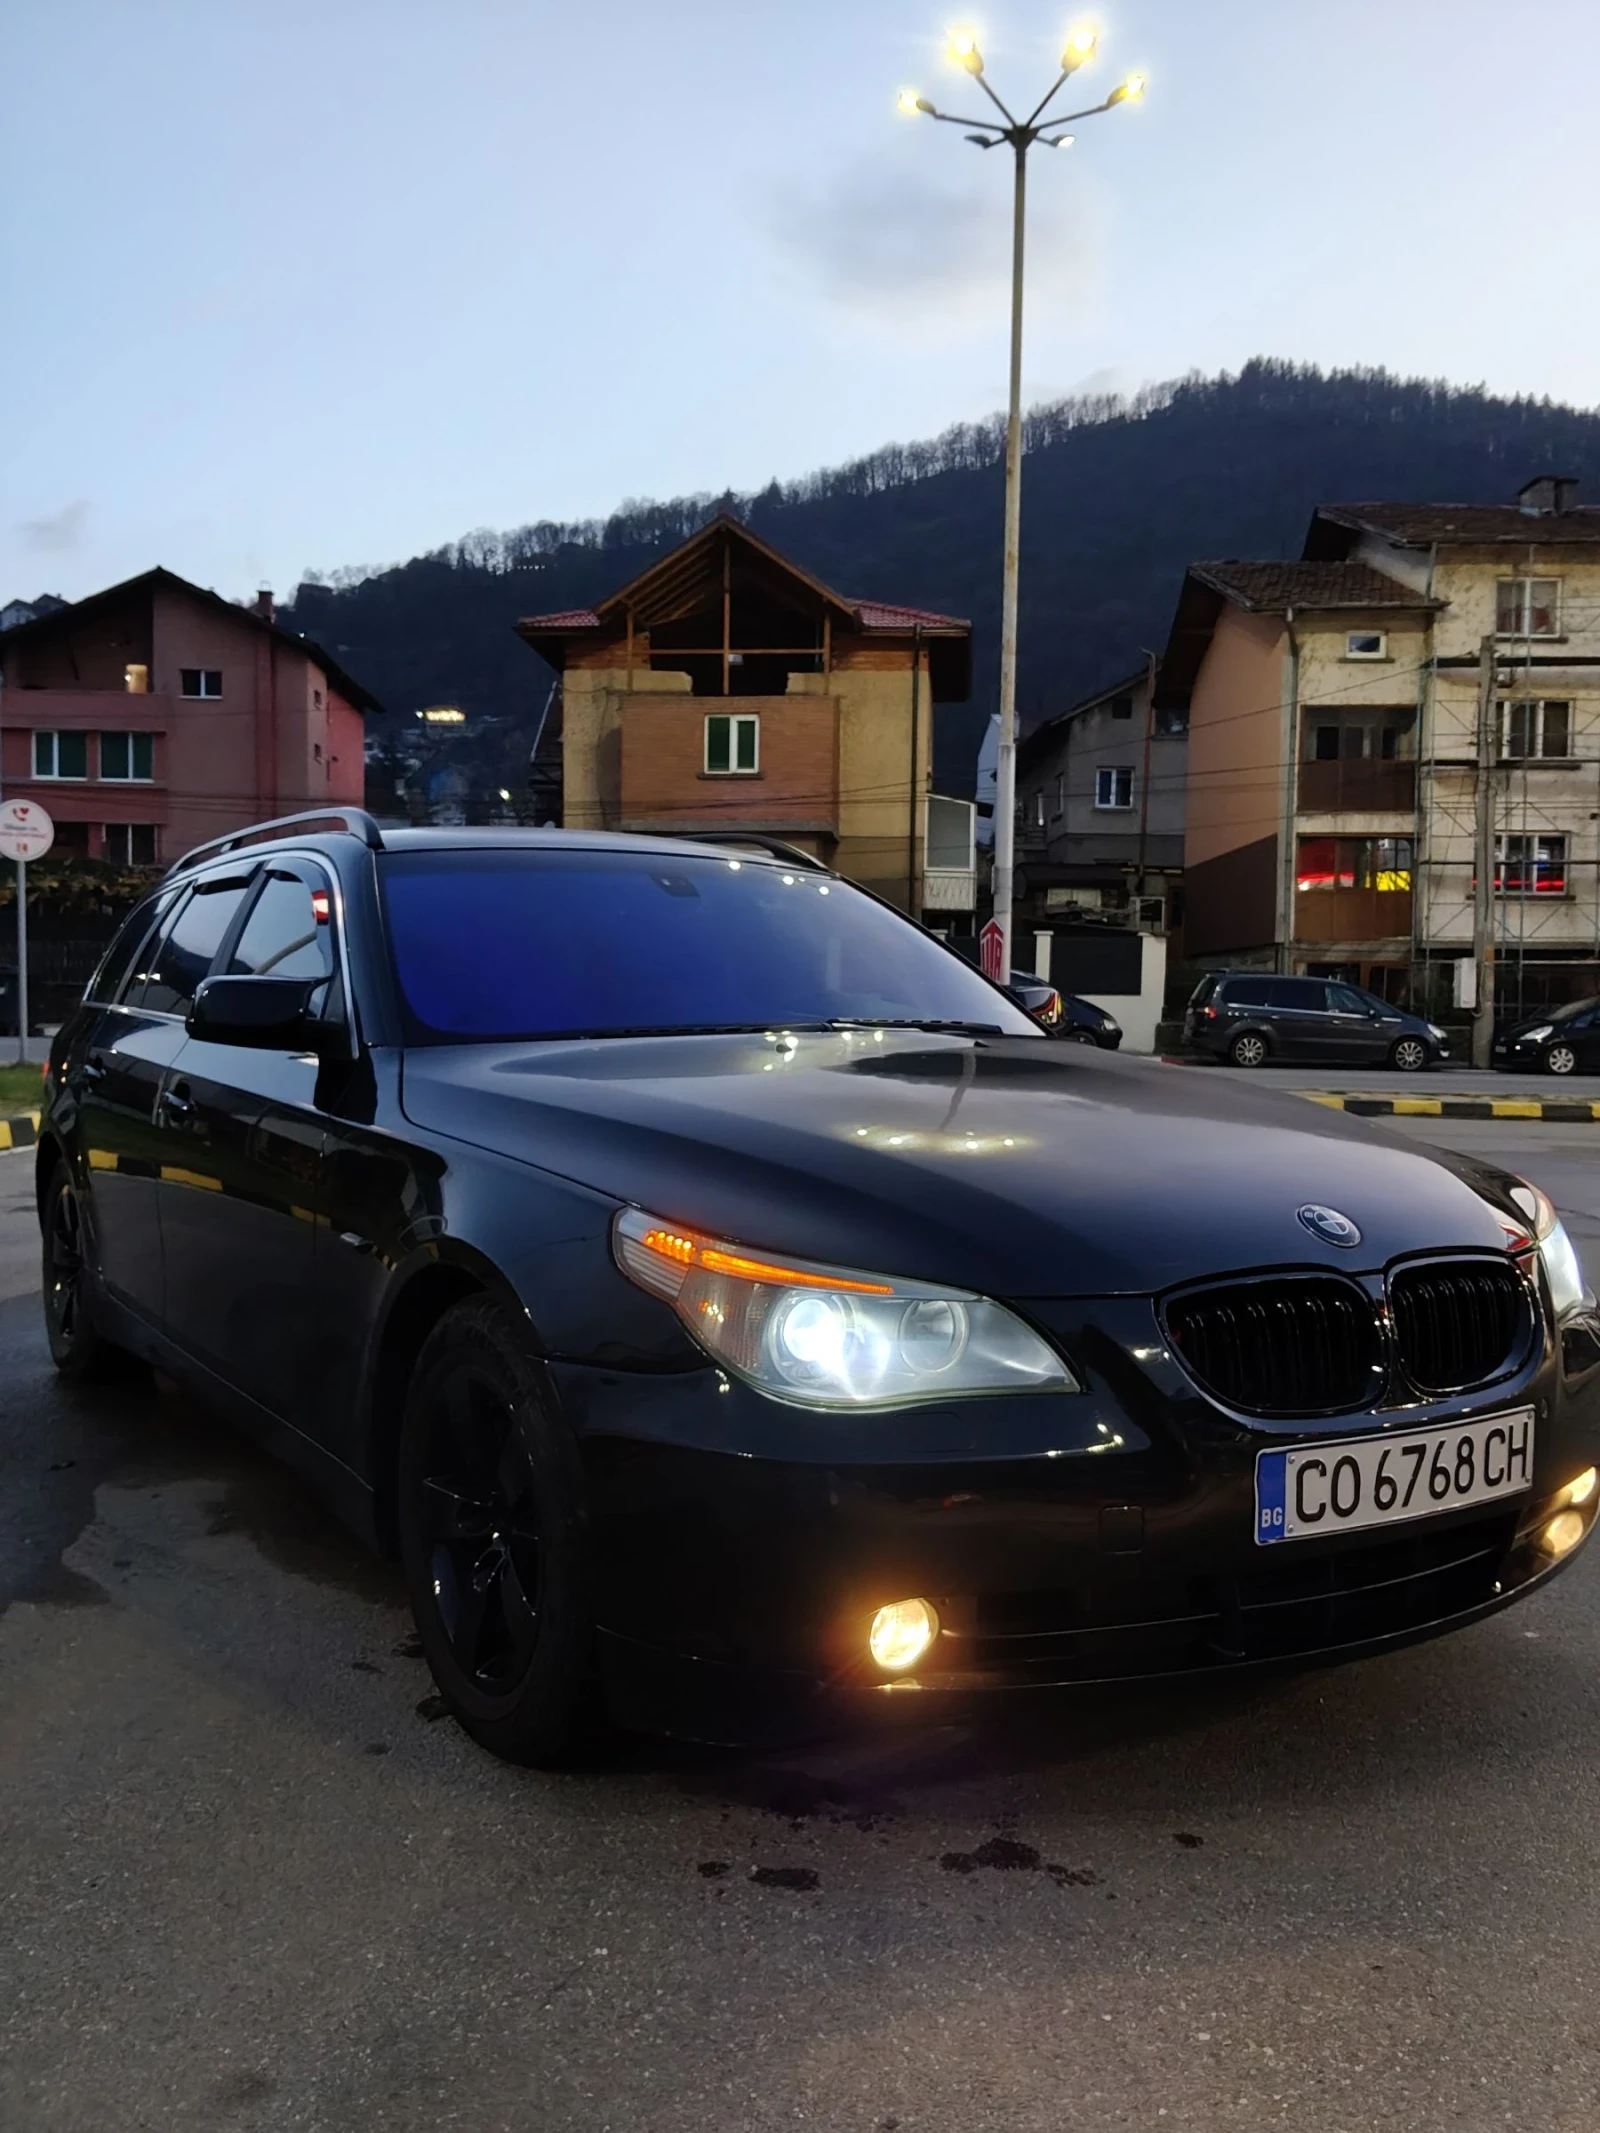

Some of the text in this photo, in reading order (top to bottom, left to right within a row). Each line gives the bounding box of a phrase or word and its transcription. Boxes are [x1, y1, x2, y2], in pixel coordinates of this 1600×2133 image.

[1295, 1421, 1529, 1523] CO 6768 CH
[1261, 1506, 1283, 1528] BG
